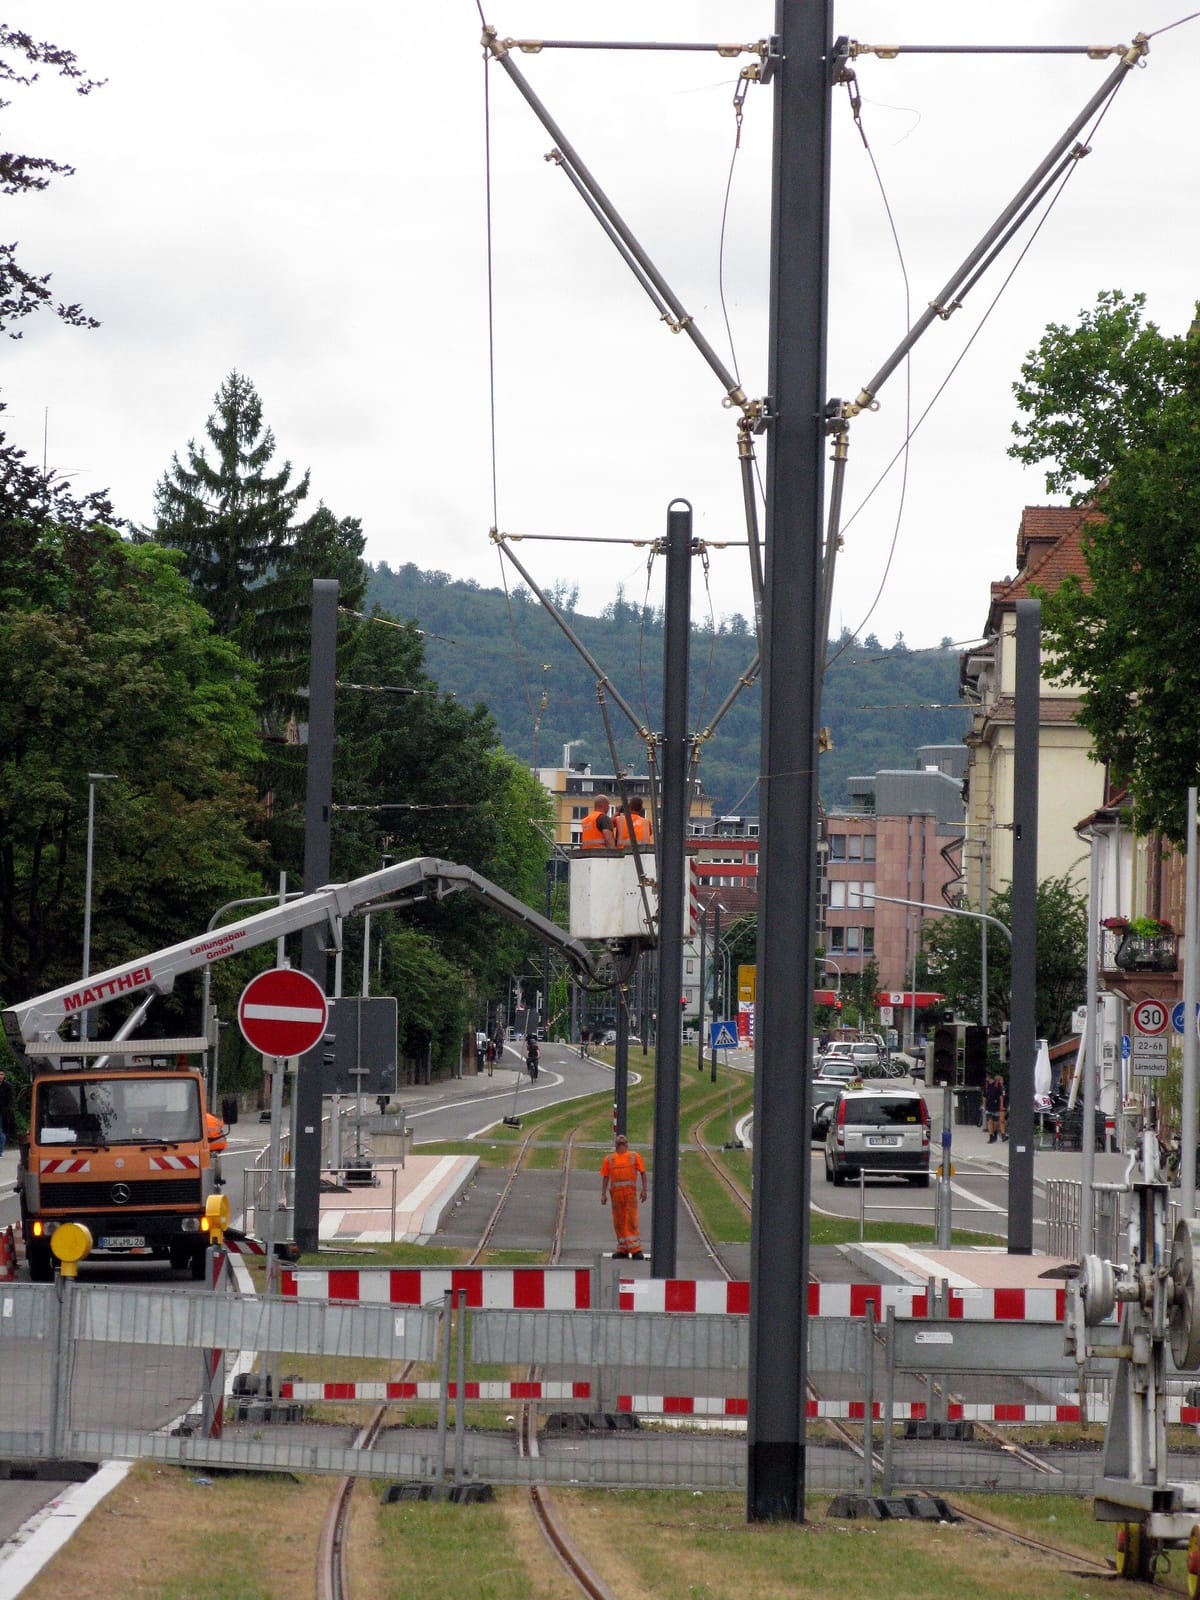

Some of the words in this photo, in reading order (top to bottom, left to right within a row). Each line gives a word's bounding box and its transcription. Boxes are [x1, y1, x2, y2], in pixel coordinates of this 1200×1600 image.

[190, 930, 246, 955] Leitungsbau
[206, 944, 234, 960] GmbH
[63, 967, 151, 1012] MATTHEI
[1141, 1009, 1162, 1025] 30
[1135, 1063, 1166, 1071] Lärmschutz
